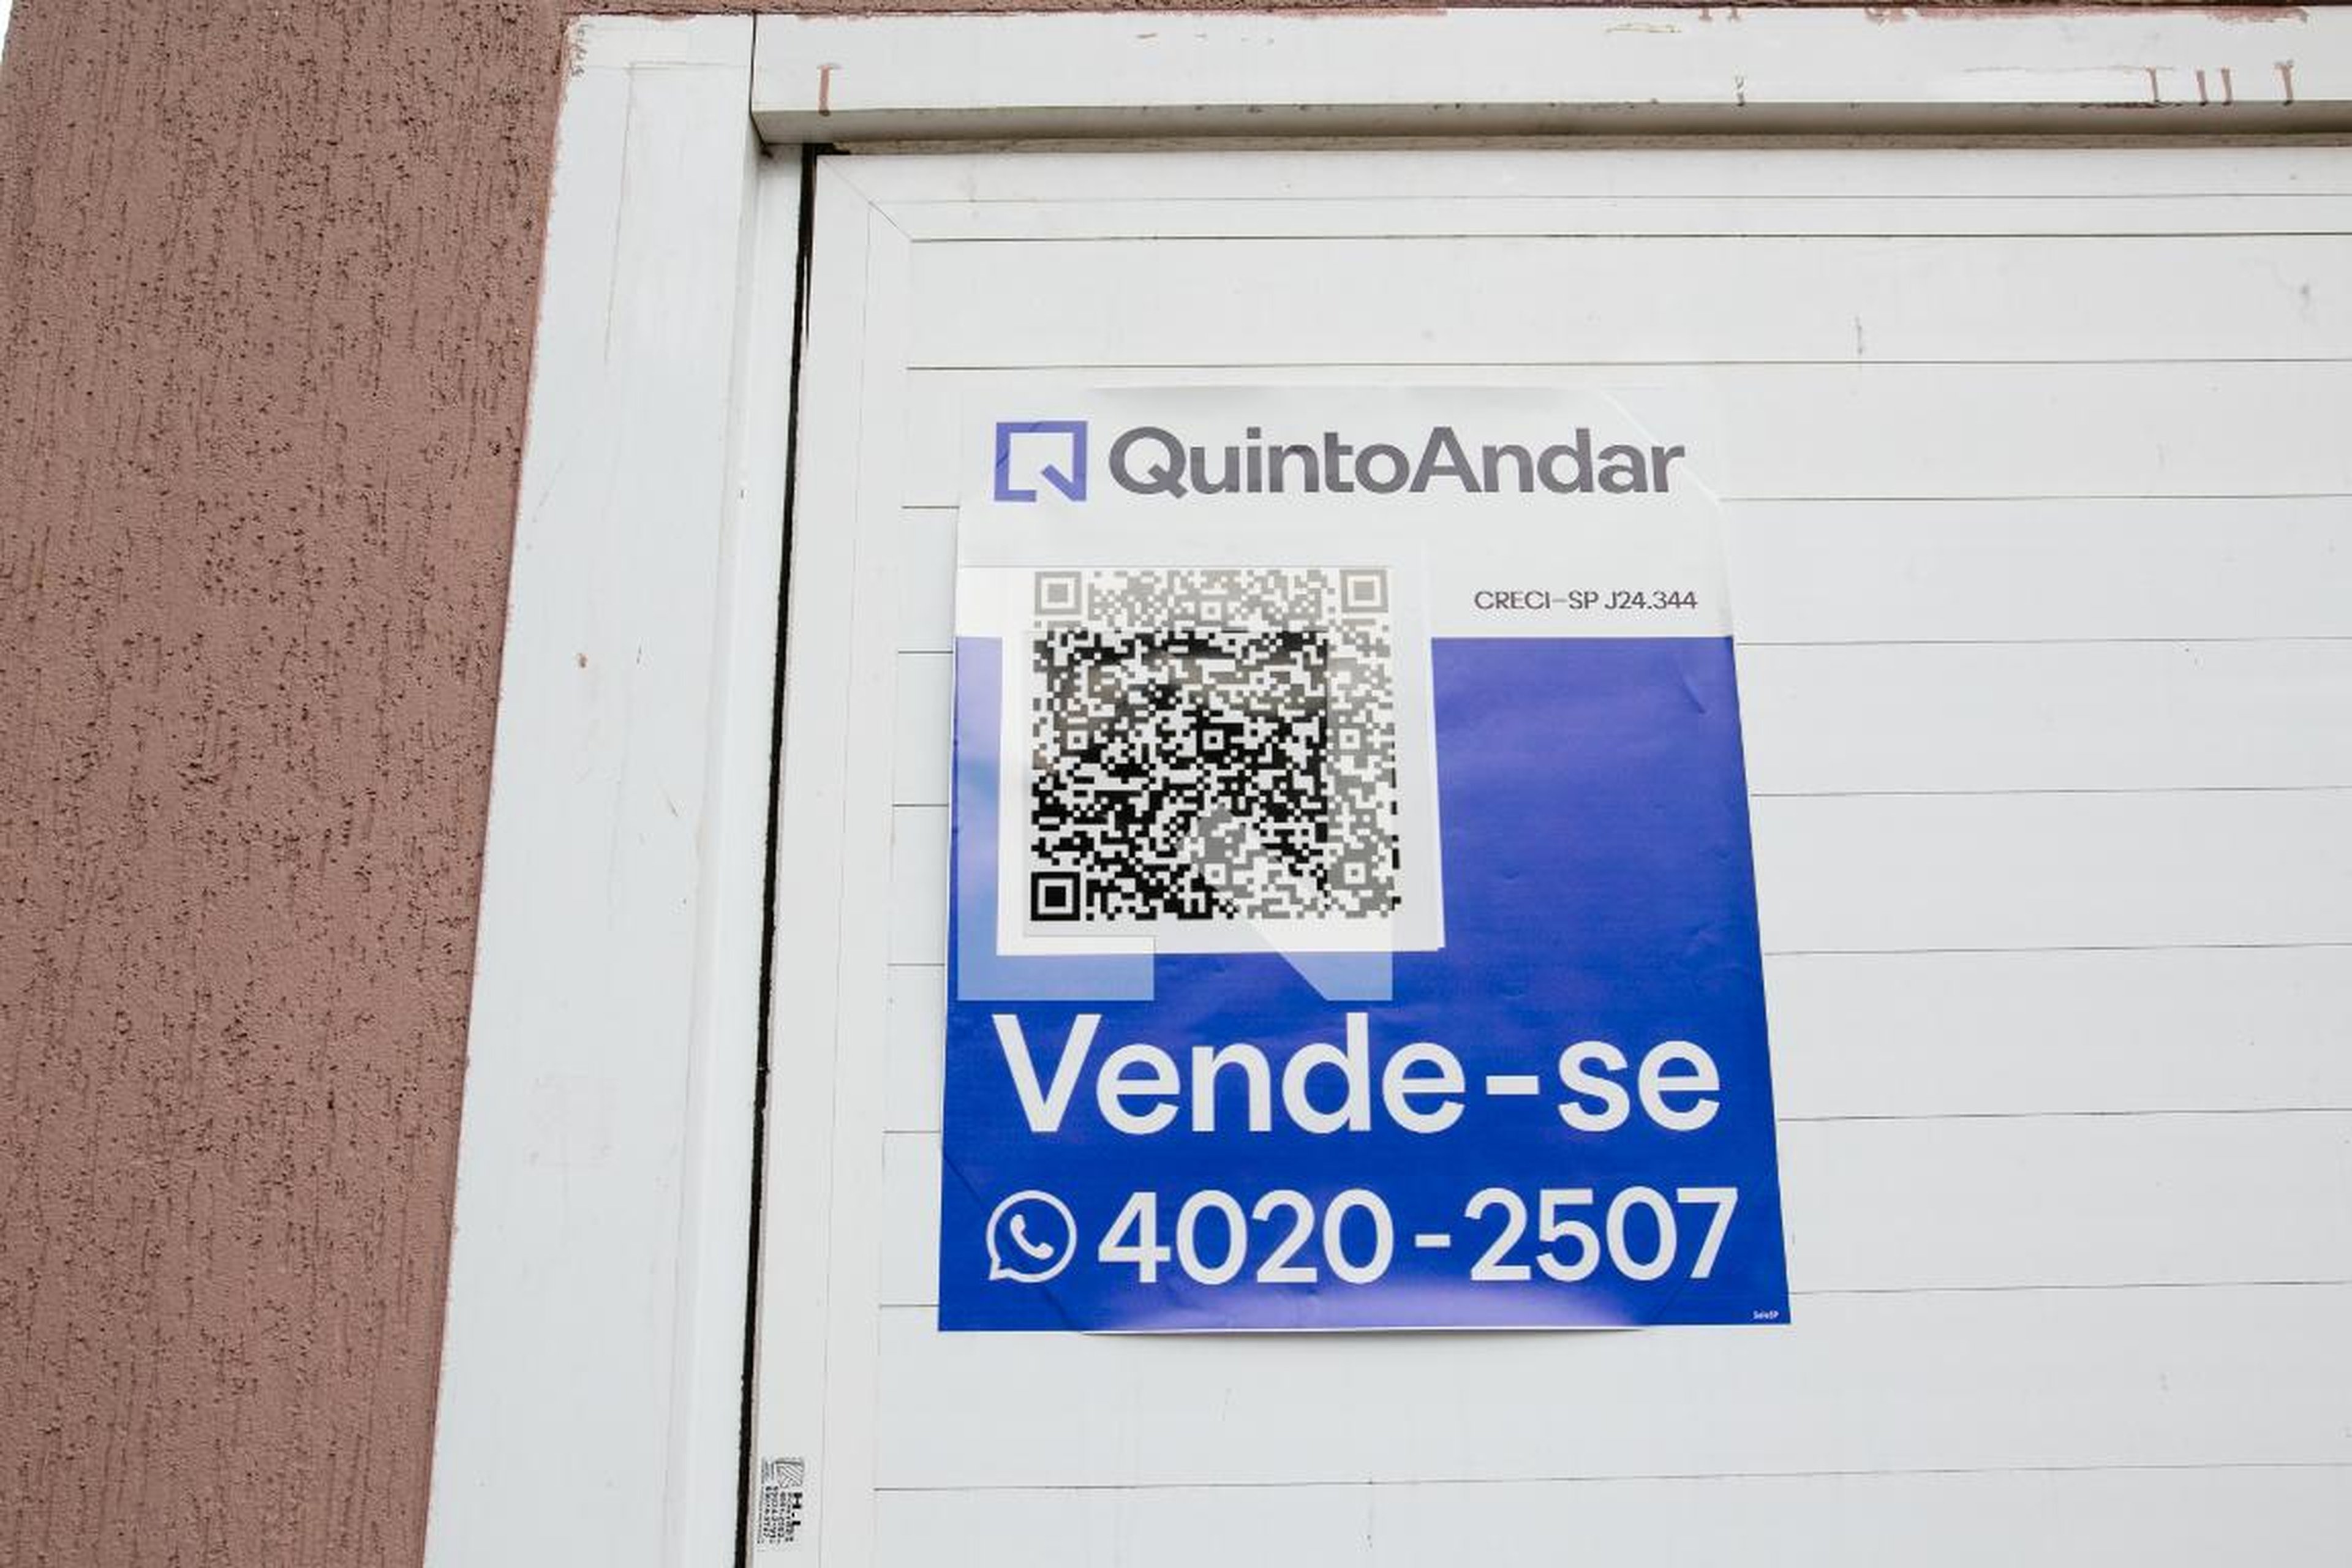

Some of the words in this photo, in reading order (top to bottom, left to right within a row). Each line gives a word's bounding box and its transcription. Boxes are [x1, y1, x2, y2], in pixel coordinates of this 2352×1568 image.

[1108, 425, 1686, 500] QuintoAndar
[1473, 589, 1599, 610] CRECI-SP
[1604, 589, 1698, 610] J24.344
[992, 1011, 1720, 1135] Vende-se
